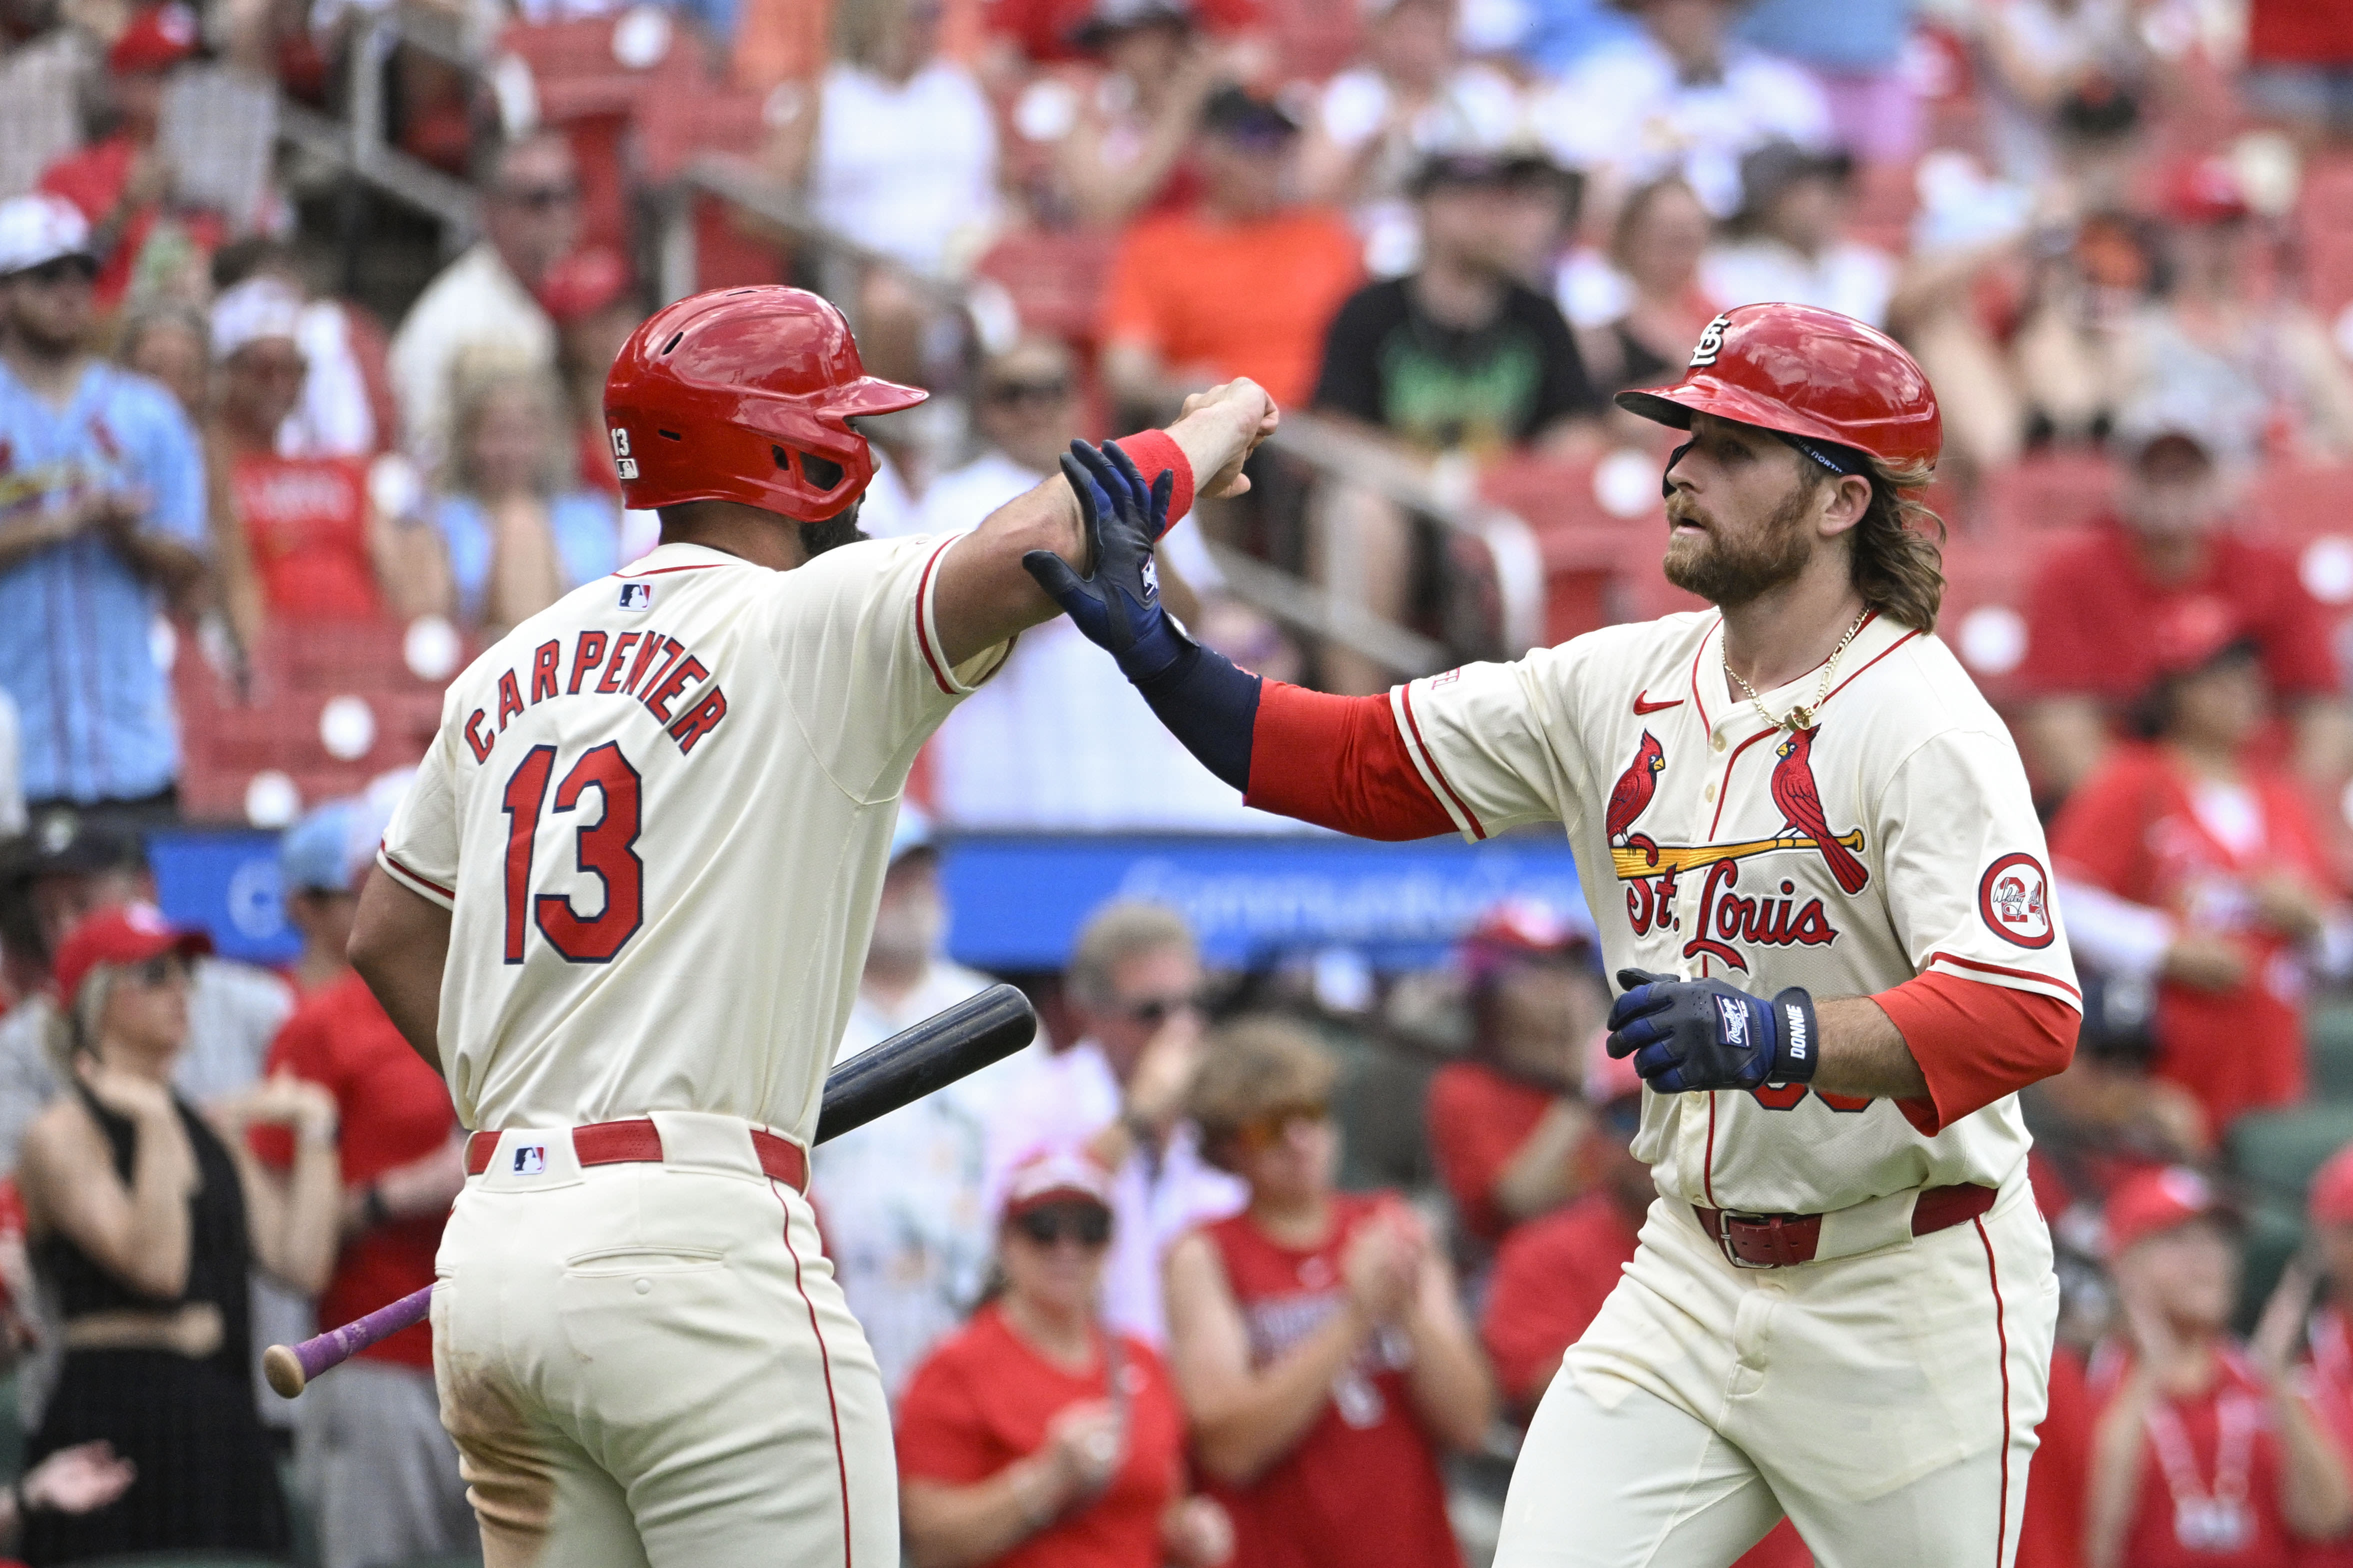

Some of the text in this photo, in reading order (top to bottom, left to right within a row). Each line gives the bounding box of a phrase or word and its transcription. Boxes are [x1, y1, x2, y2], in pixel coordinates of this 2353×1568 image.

[611, 428, 630, 457] 13
[464, 630, 728, 766] CARPENTER
[502, 740, 644, 965] 13
[1626, 834, 1680, 937] St.
[1682, 857, 1840, 977] Louis
[1722, 998, 1742, 1044] Rawlings
[1785, 1004, 1806, 1060] DONNIE
